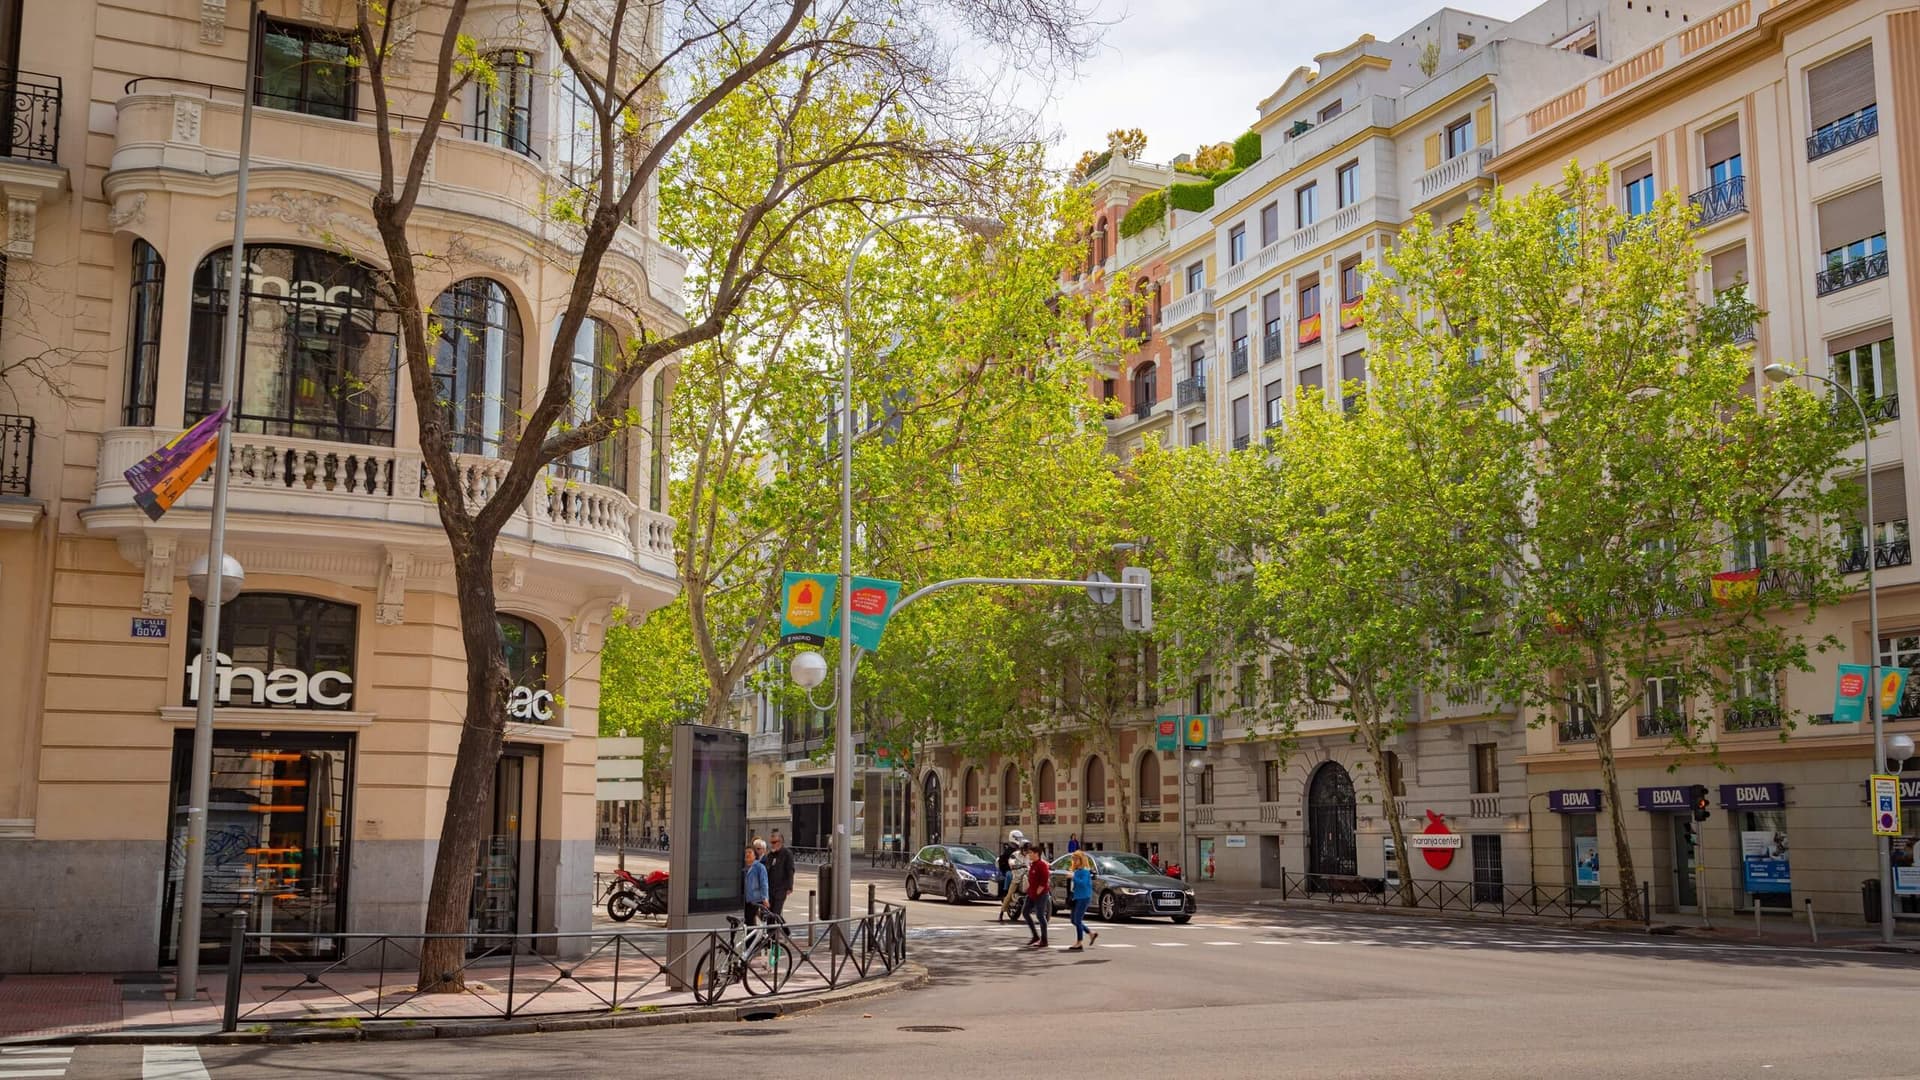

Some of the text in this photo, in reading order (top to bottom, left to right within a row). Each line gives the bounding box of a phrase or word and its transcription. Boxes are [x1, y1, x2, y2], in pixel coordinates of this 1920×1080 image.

[136, 627, 162, 636] GOYA
[186, 651, 353, 706] fnac
[1562, 792, 1590, 806] BBVA
[1653, 790, 1683, 804] BBVA
[1736, 786, 1770, 801] BBVA
[1413, 836, 1460, 846] naranja center
